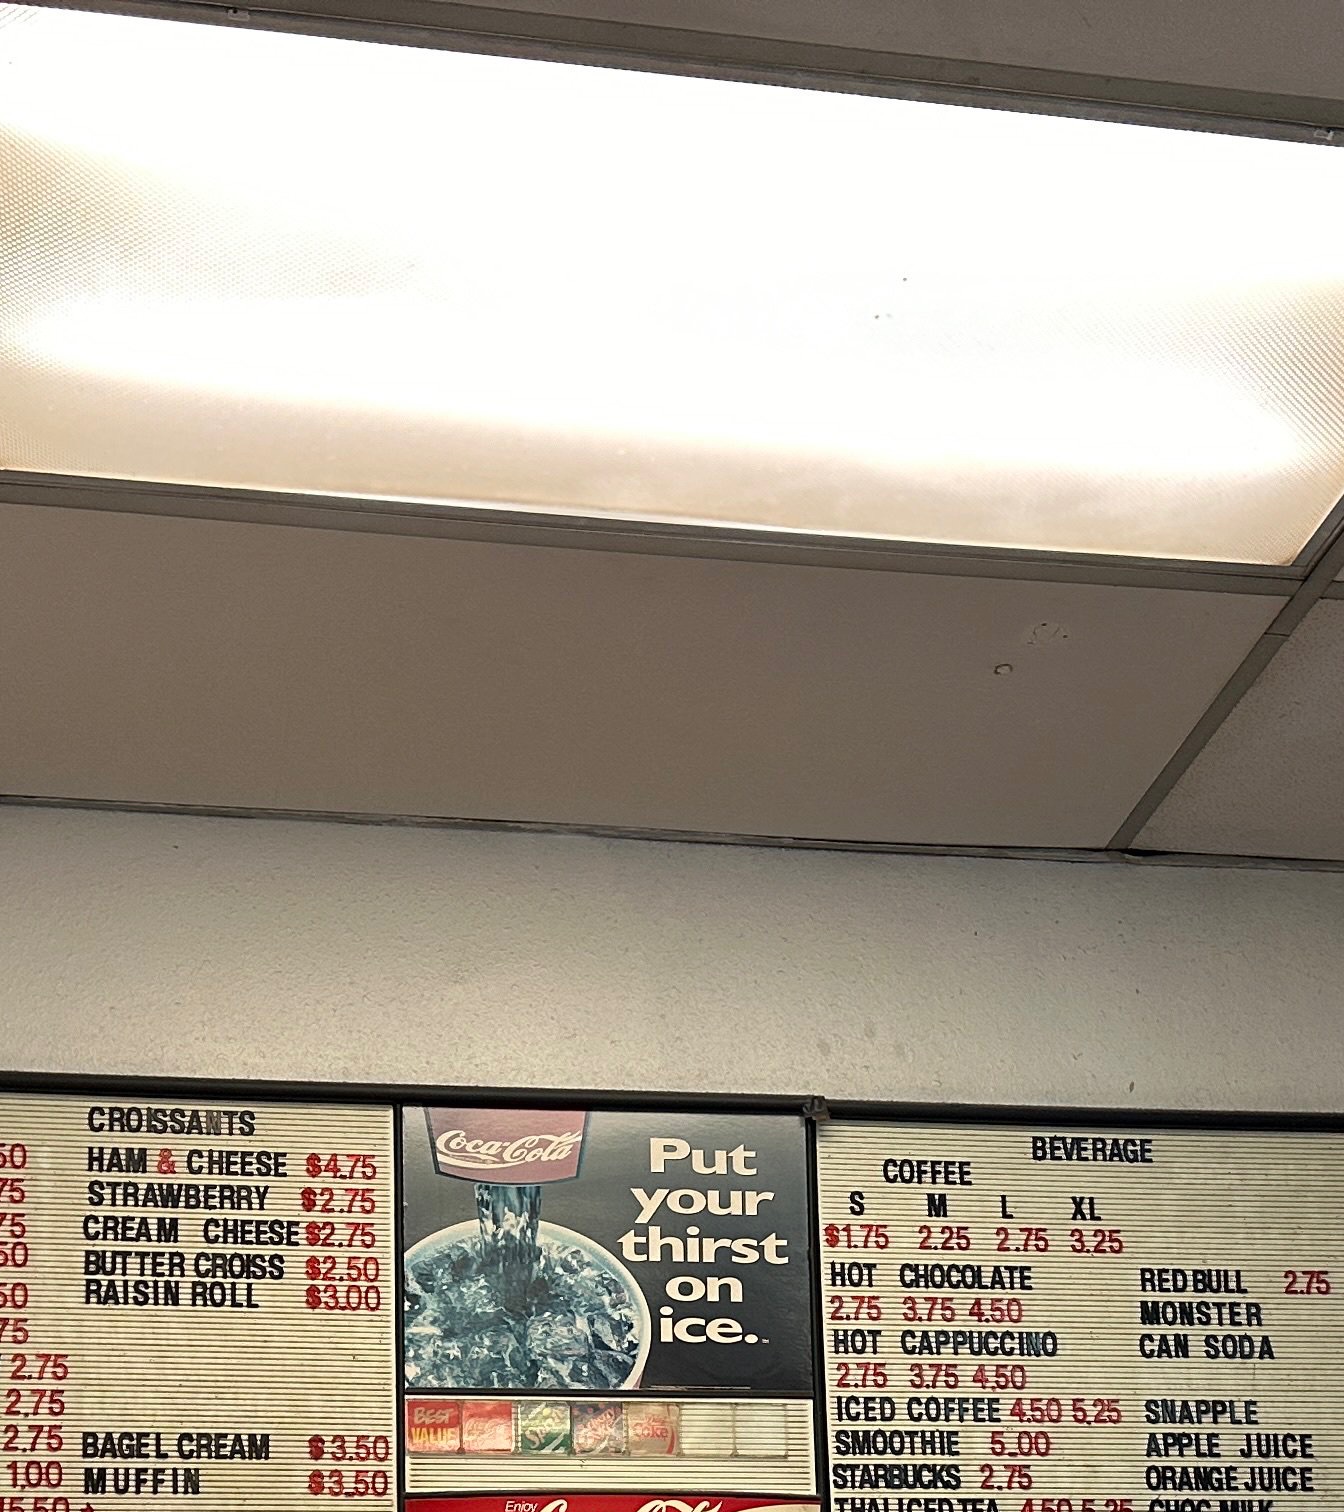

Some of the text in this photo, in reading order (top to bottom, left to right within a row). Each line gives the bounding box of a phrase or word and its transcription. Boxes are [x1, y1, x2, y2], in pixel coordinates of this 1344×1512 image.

[87, 1106, 256, 1136] CROISSANTS
[435, 1129, 583, 1168] Coca-Cola
[649, 1138, 757, 1176] Put
[1032, 1136, 1153, 1163] BEVERAGE
[87, 1146, 377, 1180] HAM & CHEESE $4.75
[882, 1159, 972, 1185] COFFEE
[87, 1180, 376, 1214] STRAWBERRY $2.75
[630, 1187, 775, 1225] your
[1071, 1196, 1102, 1221] XL
[82, 1215, 376, 1249] CREAM CHEESE $2.75
[617, 1226, 789, 1265] thirst
[918, 1225, 1123, 1254] 2.25 3.25
[83, 1250, 380, 1283] BUTTER CROISS $2.50
[830, 1261, 1033, 1290] HOT CHOCOLATE
[85, 1280, 259, 1308] RAISIN ROLL
[665, 1276, 743, 1303] on
[659, 1306, 759, 1344] ice.
[1139, 1300, 1263, 1327] MONSTER
[833, 1329, 1057, 1358] HOT CAPPUCCINO
[1139, 1333, 1275, 1360] CAN SODA
[835, 1396, 1001, 1423] ICED COFFEE
[1144, 1398, 1259, 1425] SNAPPLE
[82, 1432, 390, 1462] BAGEL CREAM $3.50
[835, 1429, 960, 1457] SMOOTHIE
[1146, 1432, 1314, 1459] APPLE JUICE
[83, 1467, 201, 1494] MUFFIN
[832, 1463, 961, 1490] STARBUCKS
[1144, 1465, 1314, 1492] ORANGE JUICE
